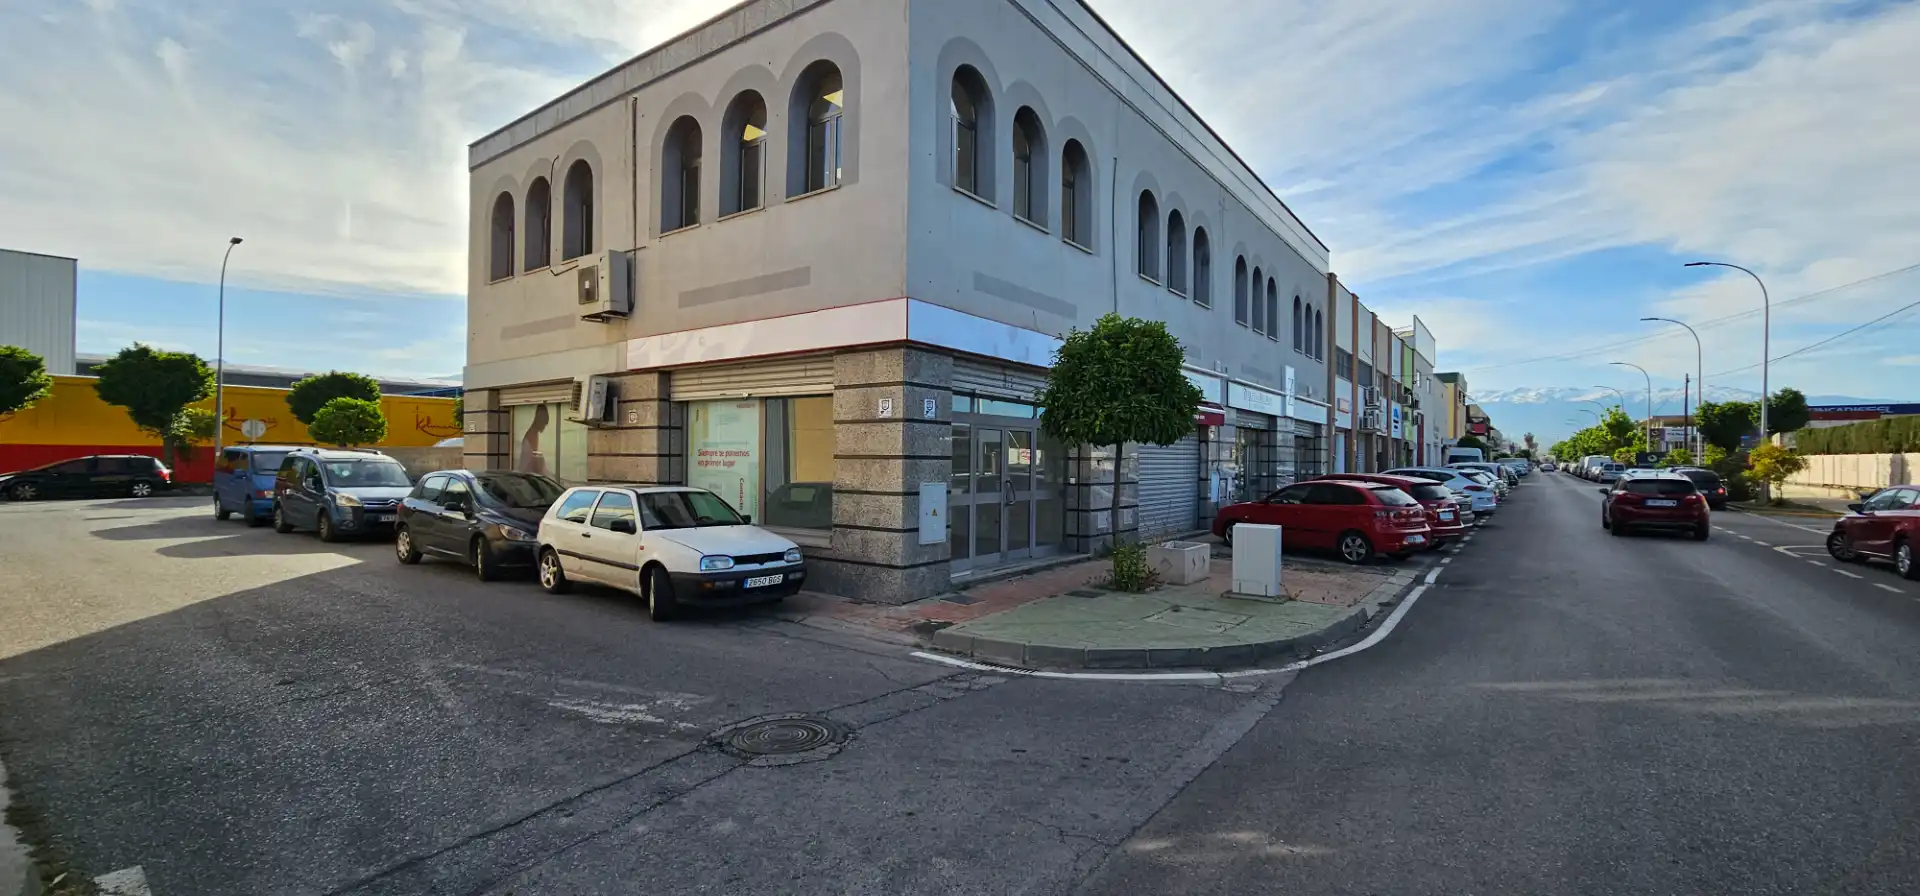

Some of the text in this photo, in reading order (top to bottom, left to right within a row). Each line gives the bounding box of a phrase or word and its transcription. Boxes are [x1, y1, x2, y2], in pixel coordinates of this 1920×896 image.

[698, 448, 718, 459] Siempre
[725, 450, 750, 458] ponemos
[704, 459, 721, 468] primer
[722, 459, 736, 468] lugar
